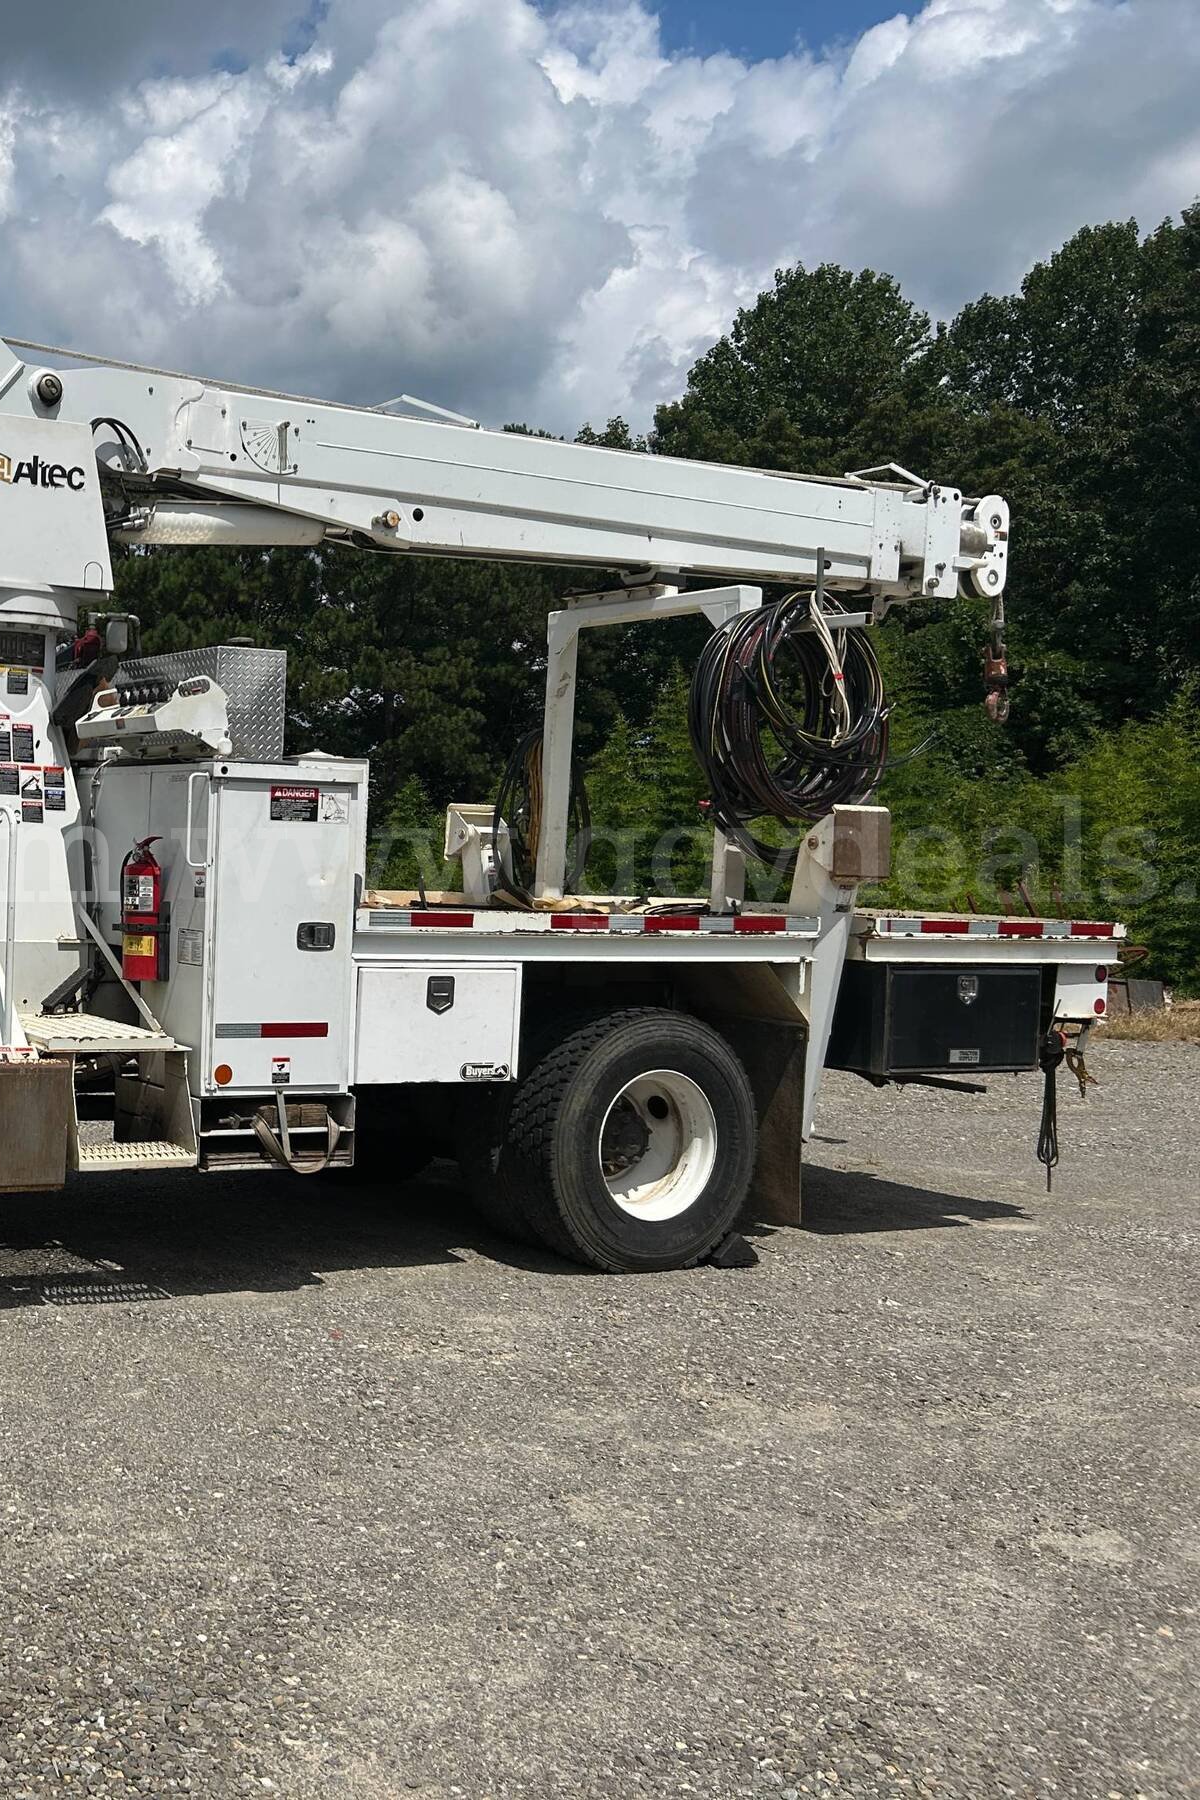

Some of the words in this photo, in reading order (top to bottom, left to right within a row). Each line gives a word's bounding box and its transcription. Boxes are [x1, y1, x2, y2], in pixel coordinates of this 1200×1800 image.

[13, 455, 85, 491] Altec
[282, 788, 316, 798] DANGER
[465, 1065, 496, 1077] Buyers
